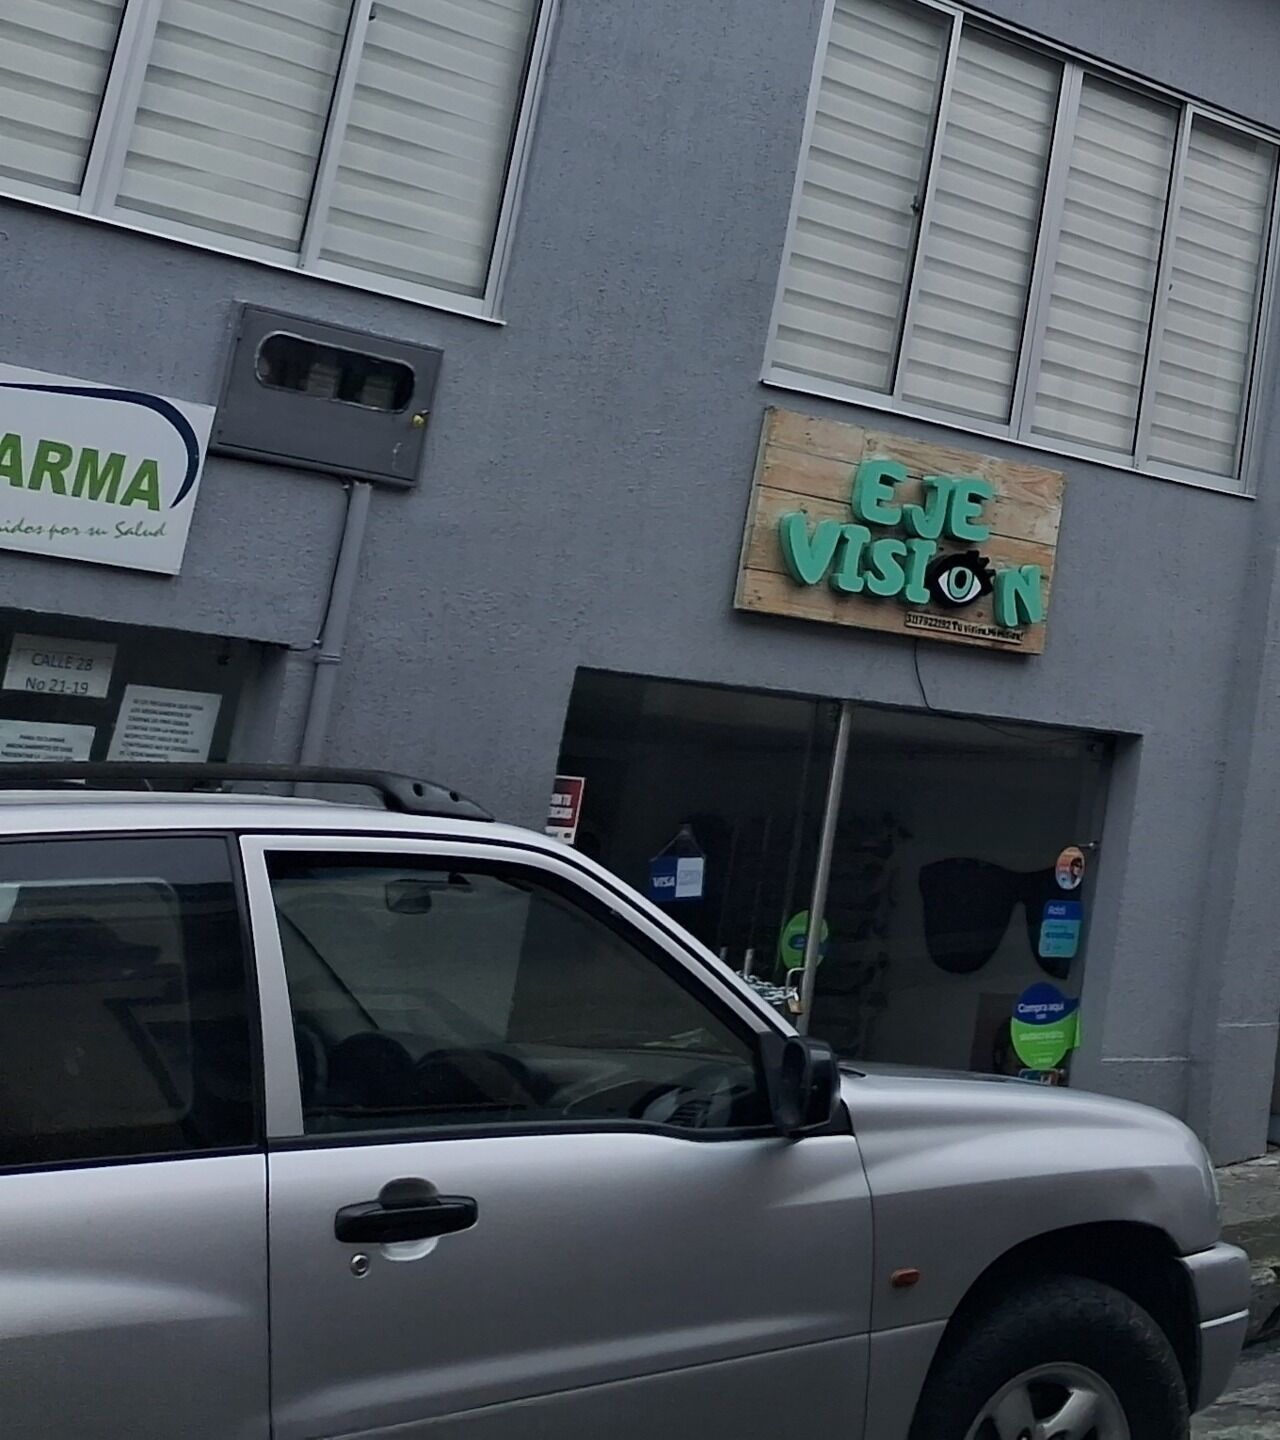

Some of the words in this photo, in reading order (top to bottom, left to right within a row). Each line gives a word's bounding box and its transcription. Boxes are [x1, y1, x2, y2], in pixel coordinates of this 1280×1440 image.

[853, 454, 993, 542] EJE
[48, 523, 80, 540] por
[85, 526, 108, 535] su
[113, 520, 167, 538] Salud
[780, 511, 1042, 628] VISION
[31, 652, 73, 670] CALLE
[76, 658, 94, 672] 28
[25, 676, 45, 691] No
[48, 678, 89, 695] 21-19
